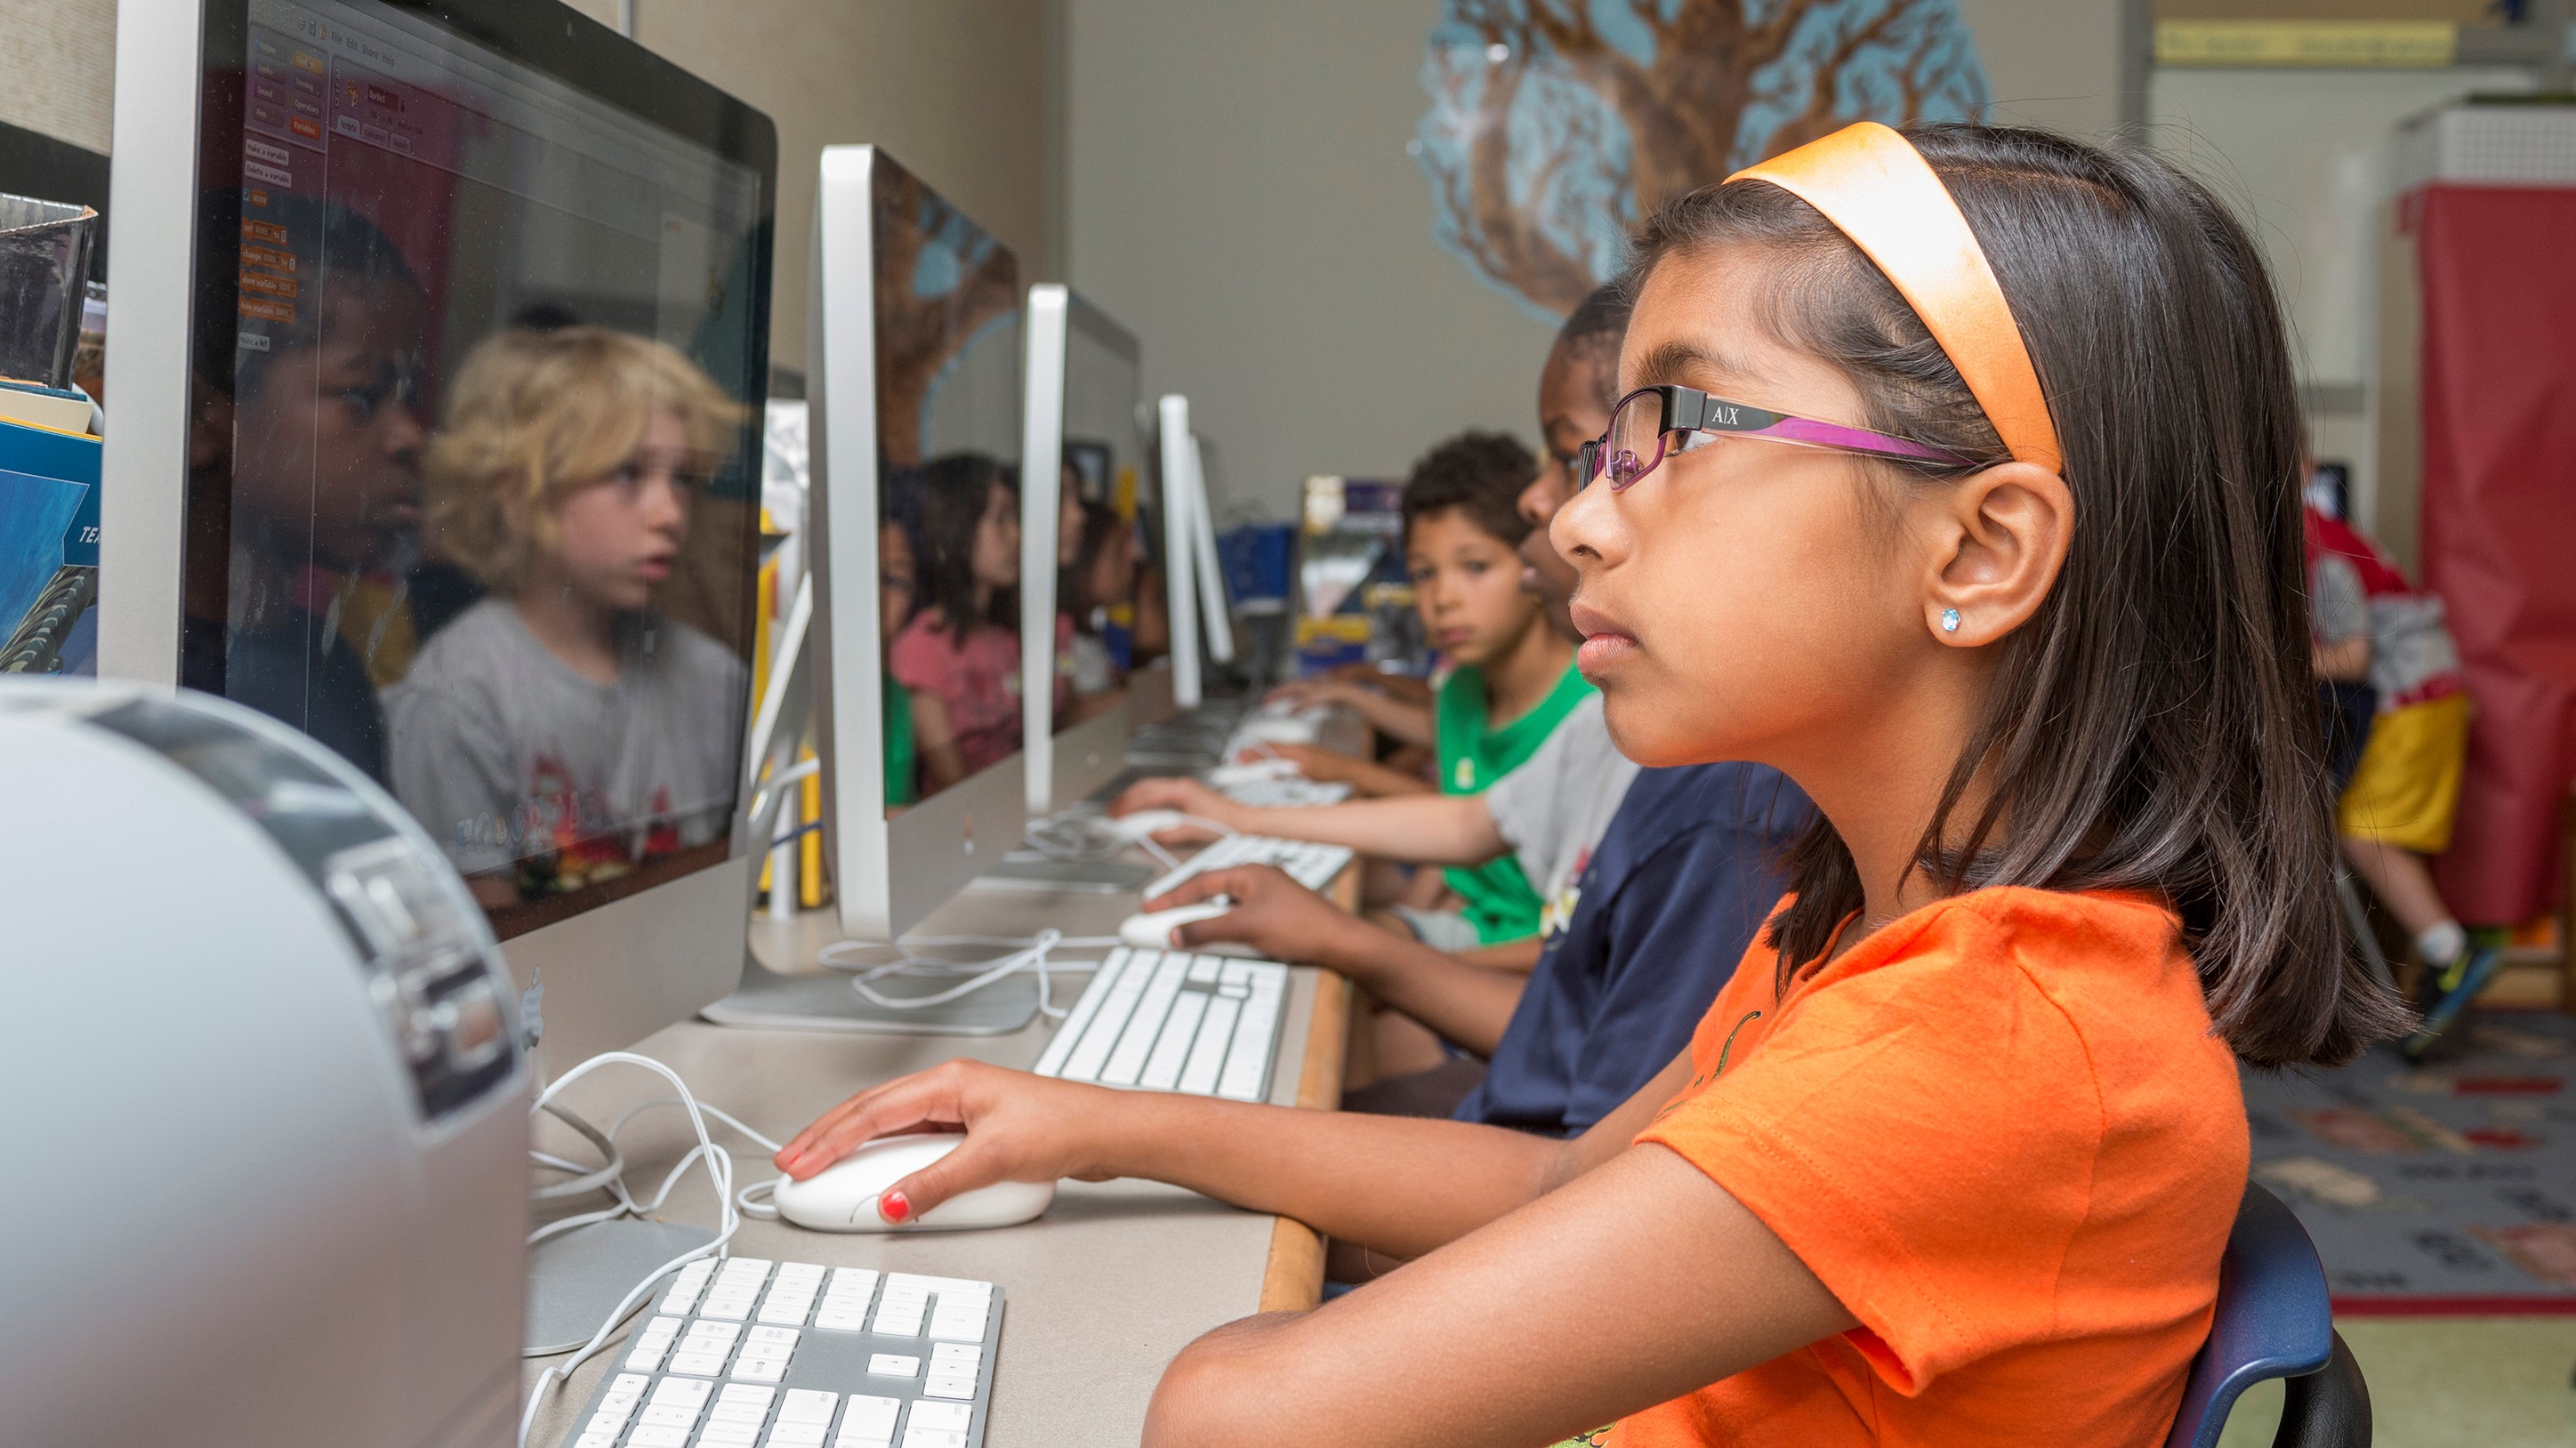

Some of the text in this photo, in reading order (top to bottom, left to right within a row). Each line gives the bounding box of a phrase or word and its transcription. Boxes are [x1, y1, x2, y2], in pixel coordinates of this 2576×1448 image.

[331, 31, 396, 68] File Edit Share Help
[294, 99, 320, 115] Operators
[294, 121, 316, 135] Variables
[247, 142, 261, 154] Make
[267, 149, 287, 161] variable
[246, 164, 263, 176] Delete
[270, 172, 290, 184] variable
[253, 194, 267, 204] score
[281, 257, 288, 269] by
[256, 278, 278, 290] variable
[254, 305, 274, 315] variable
